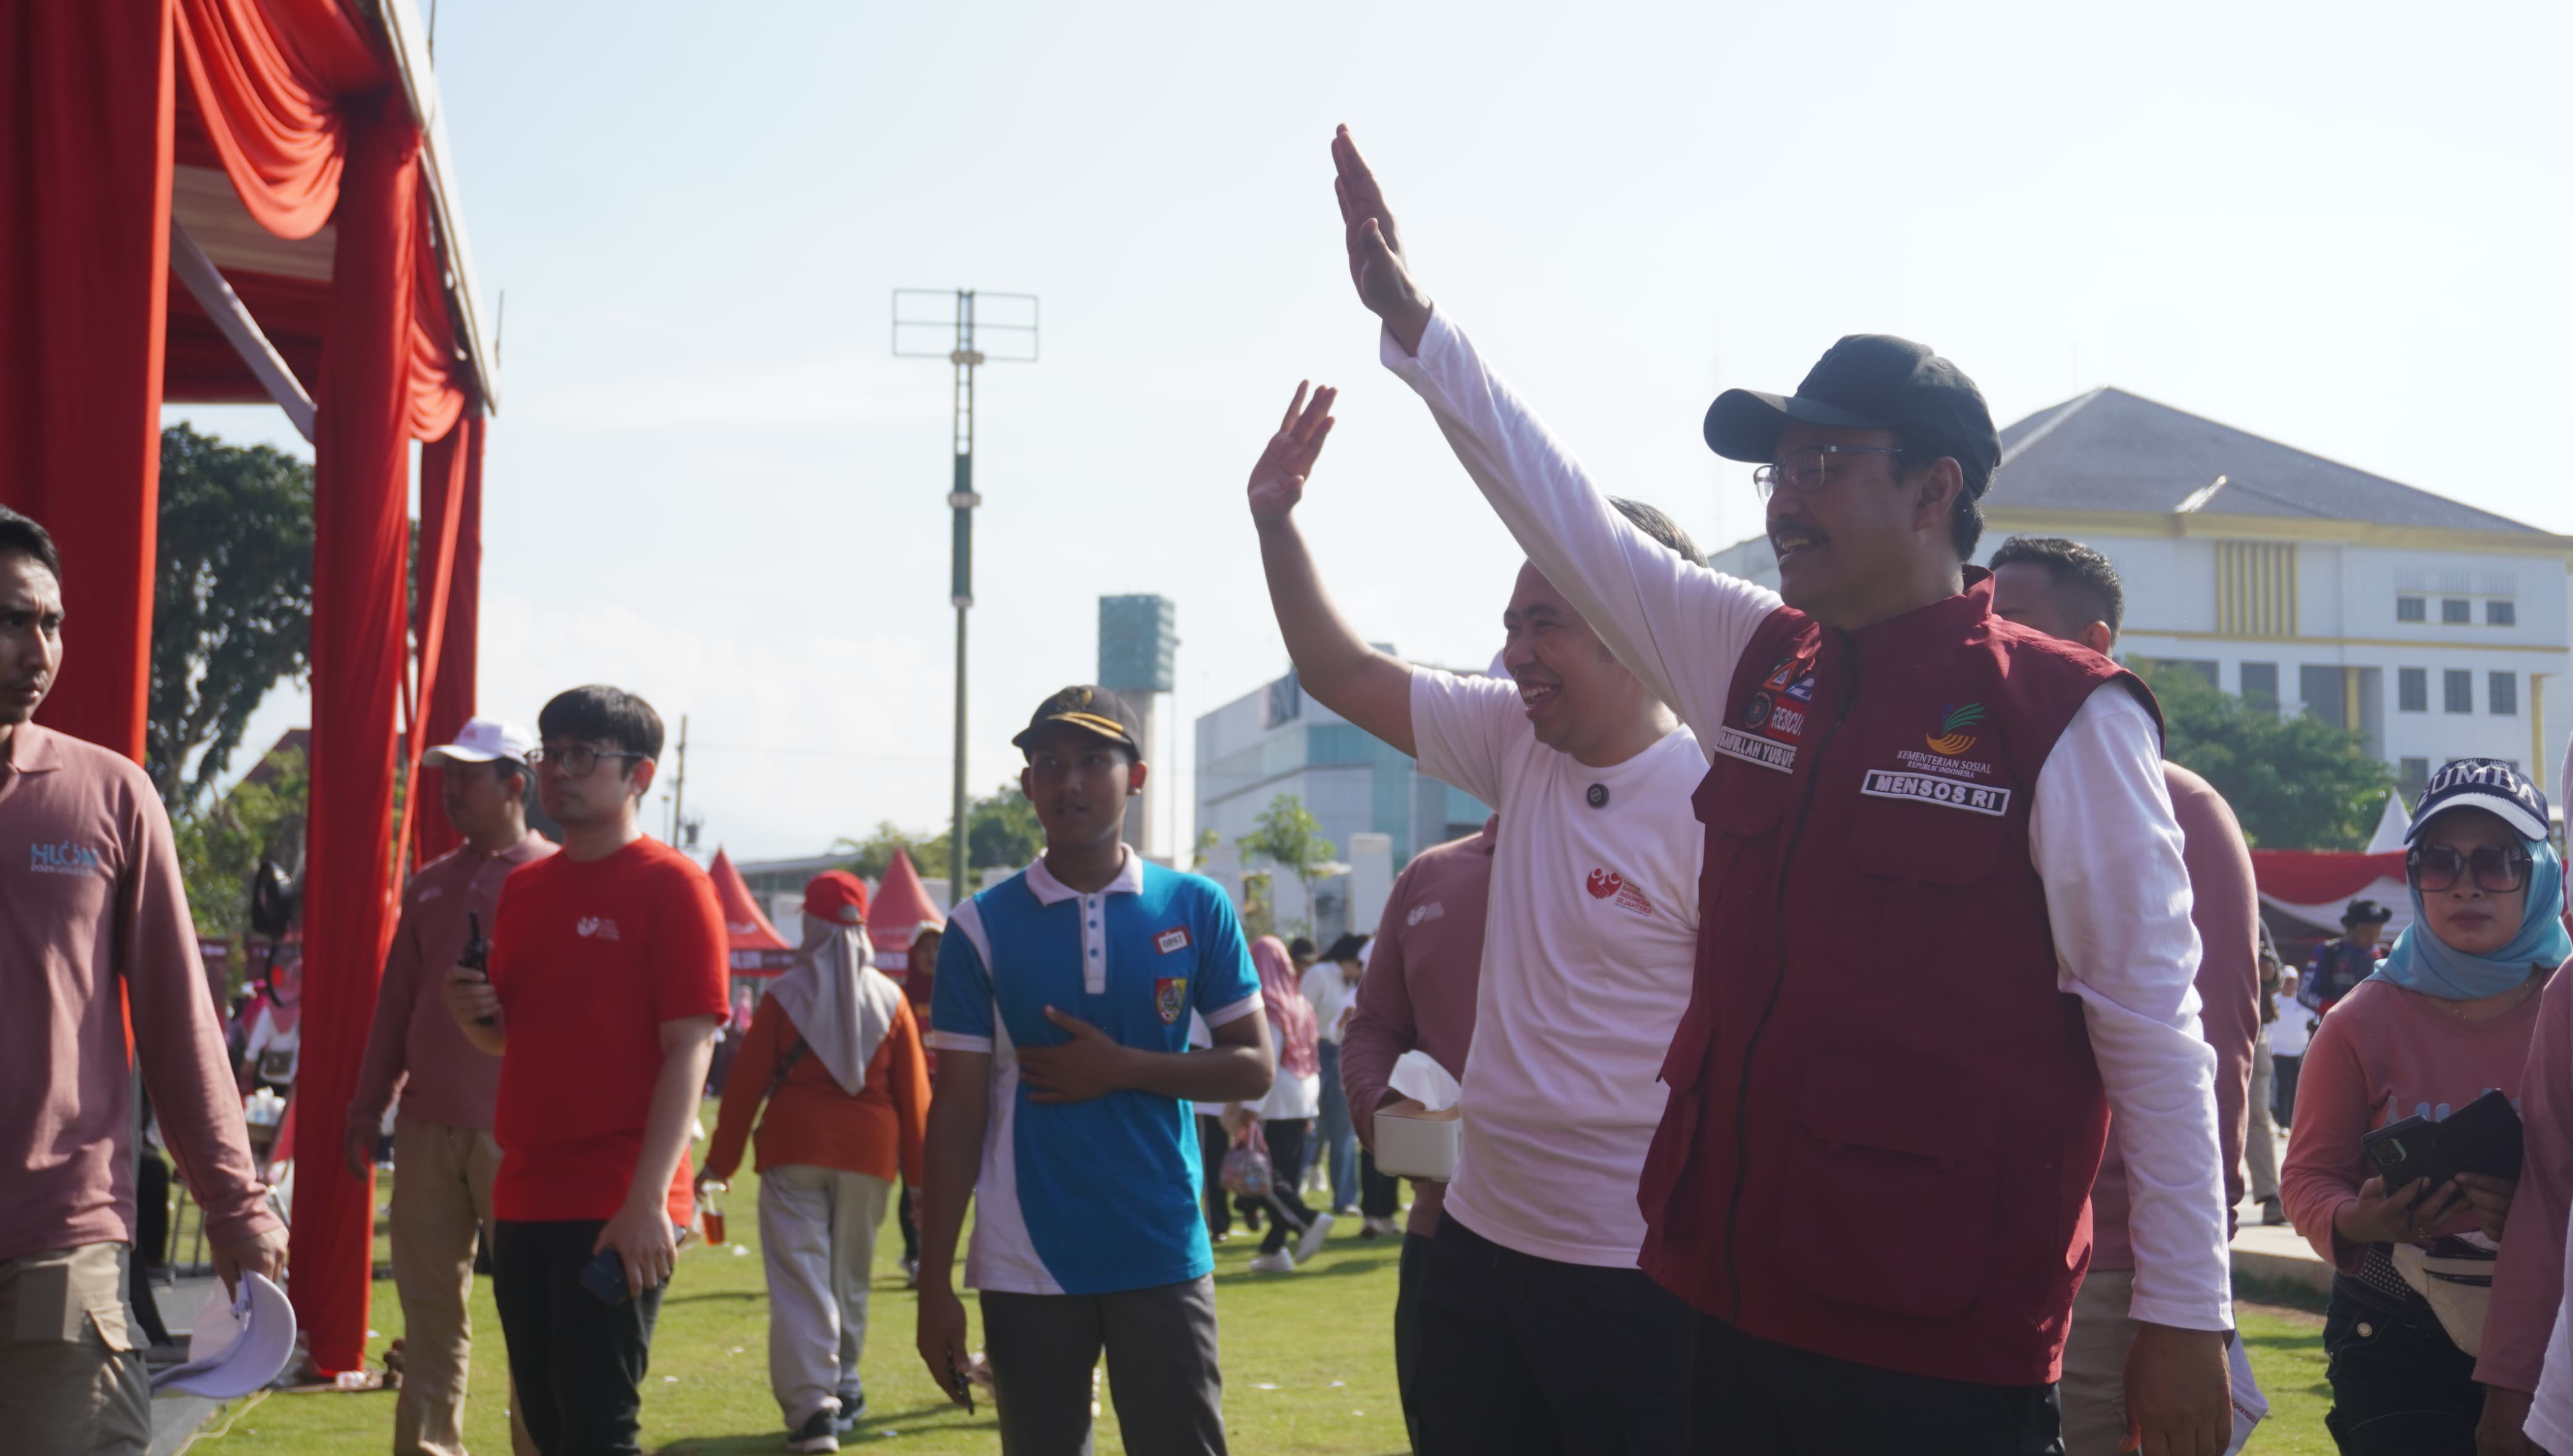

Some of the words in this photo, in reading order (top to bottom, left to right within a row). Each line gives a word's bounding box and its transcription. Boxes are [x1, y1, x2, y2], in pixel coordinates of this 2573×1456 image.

[1771, 706, 1805, 736] RESCU
[1762, 744, 1796, 768] YUSUF
[1897, 750, 1960, 769] KEMENTERIAN
[1961, 760, 1992, 774] SOSIAL
[1907, 760, 1938, 772] REPUBLIK
[1938, 766, 1975, 779] INDONESIA
[1875, 775, 1967, 804] MENSOS
[1971, 789, 1997, 810] RI
[1616, 897, 1652, 915] SEJAHTERA
